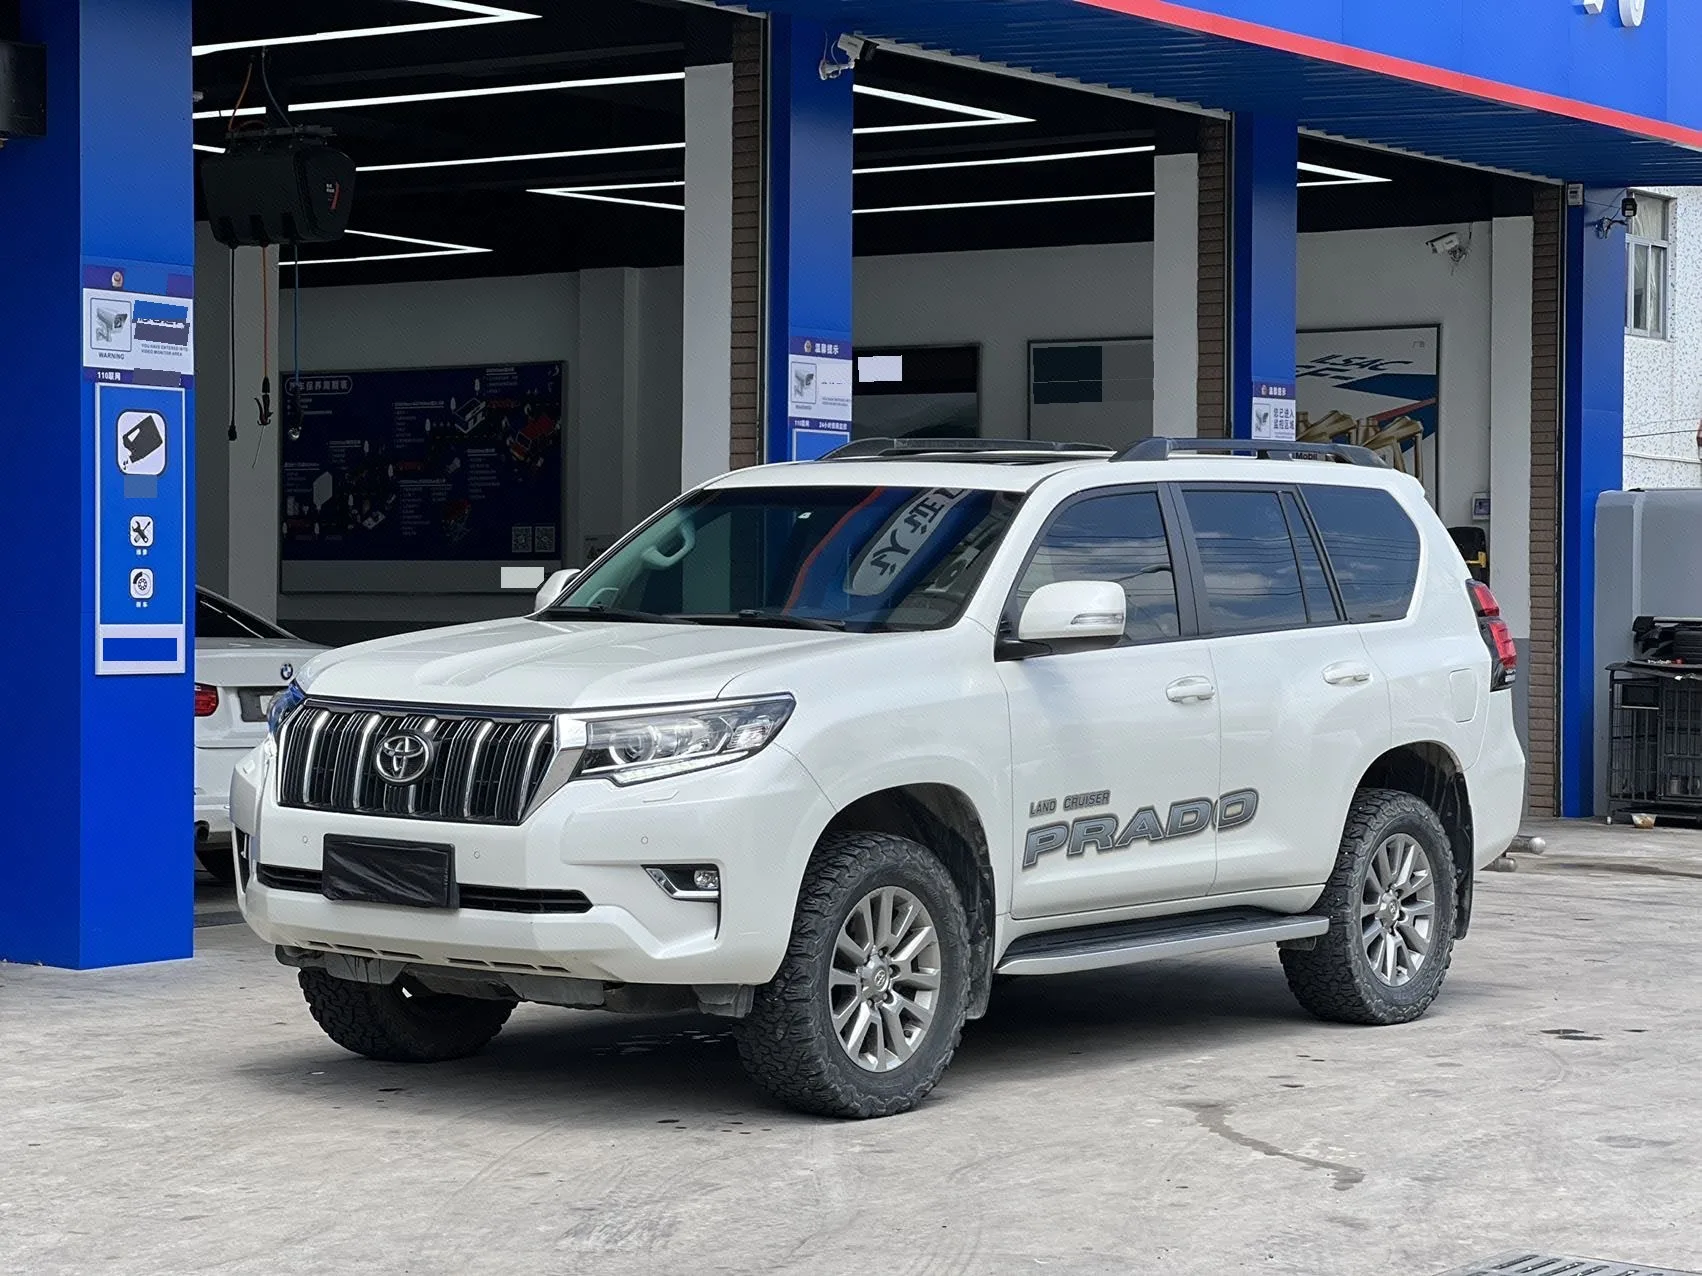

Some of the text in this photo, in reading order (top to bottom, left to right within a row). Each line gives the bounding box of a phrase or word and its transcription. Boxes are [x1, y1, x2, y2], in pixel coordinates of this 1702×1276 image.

[98, 352, 125, 360] WARNING
[97, 371, 121, 381] 110联网
[1029, 790, 1111, 818] LAND CRUISER
[1022, 788, 1259, 871] PRADO
